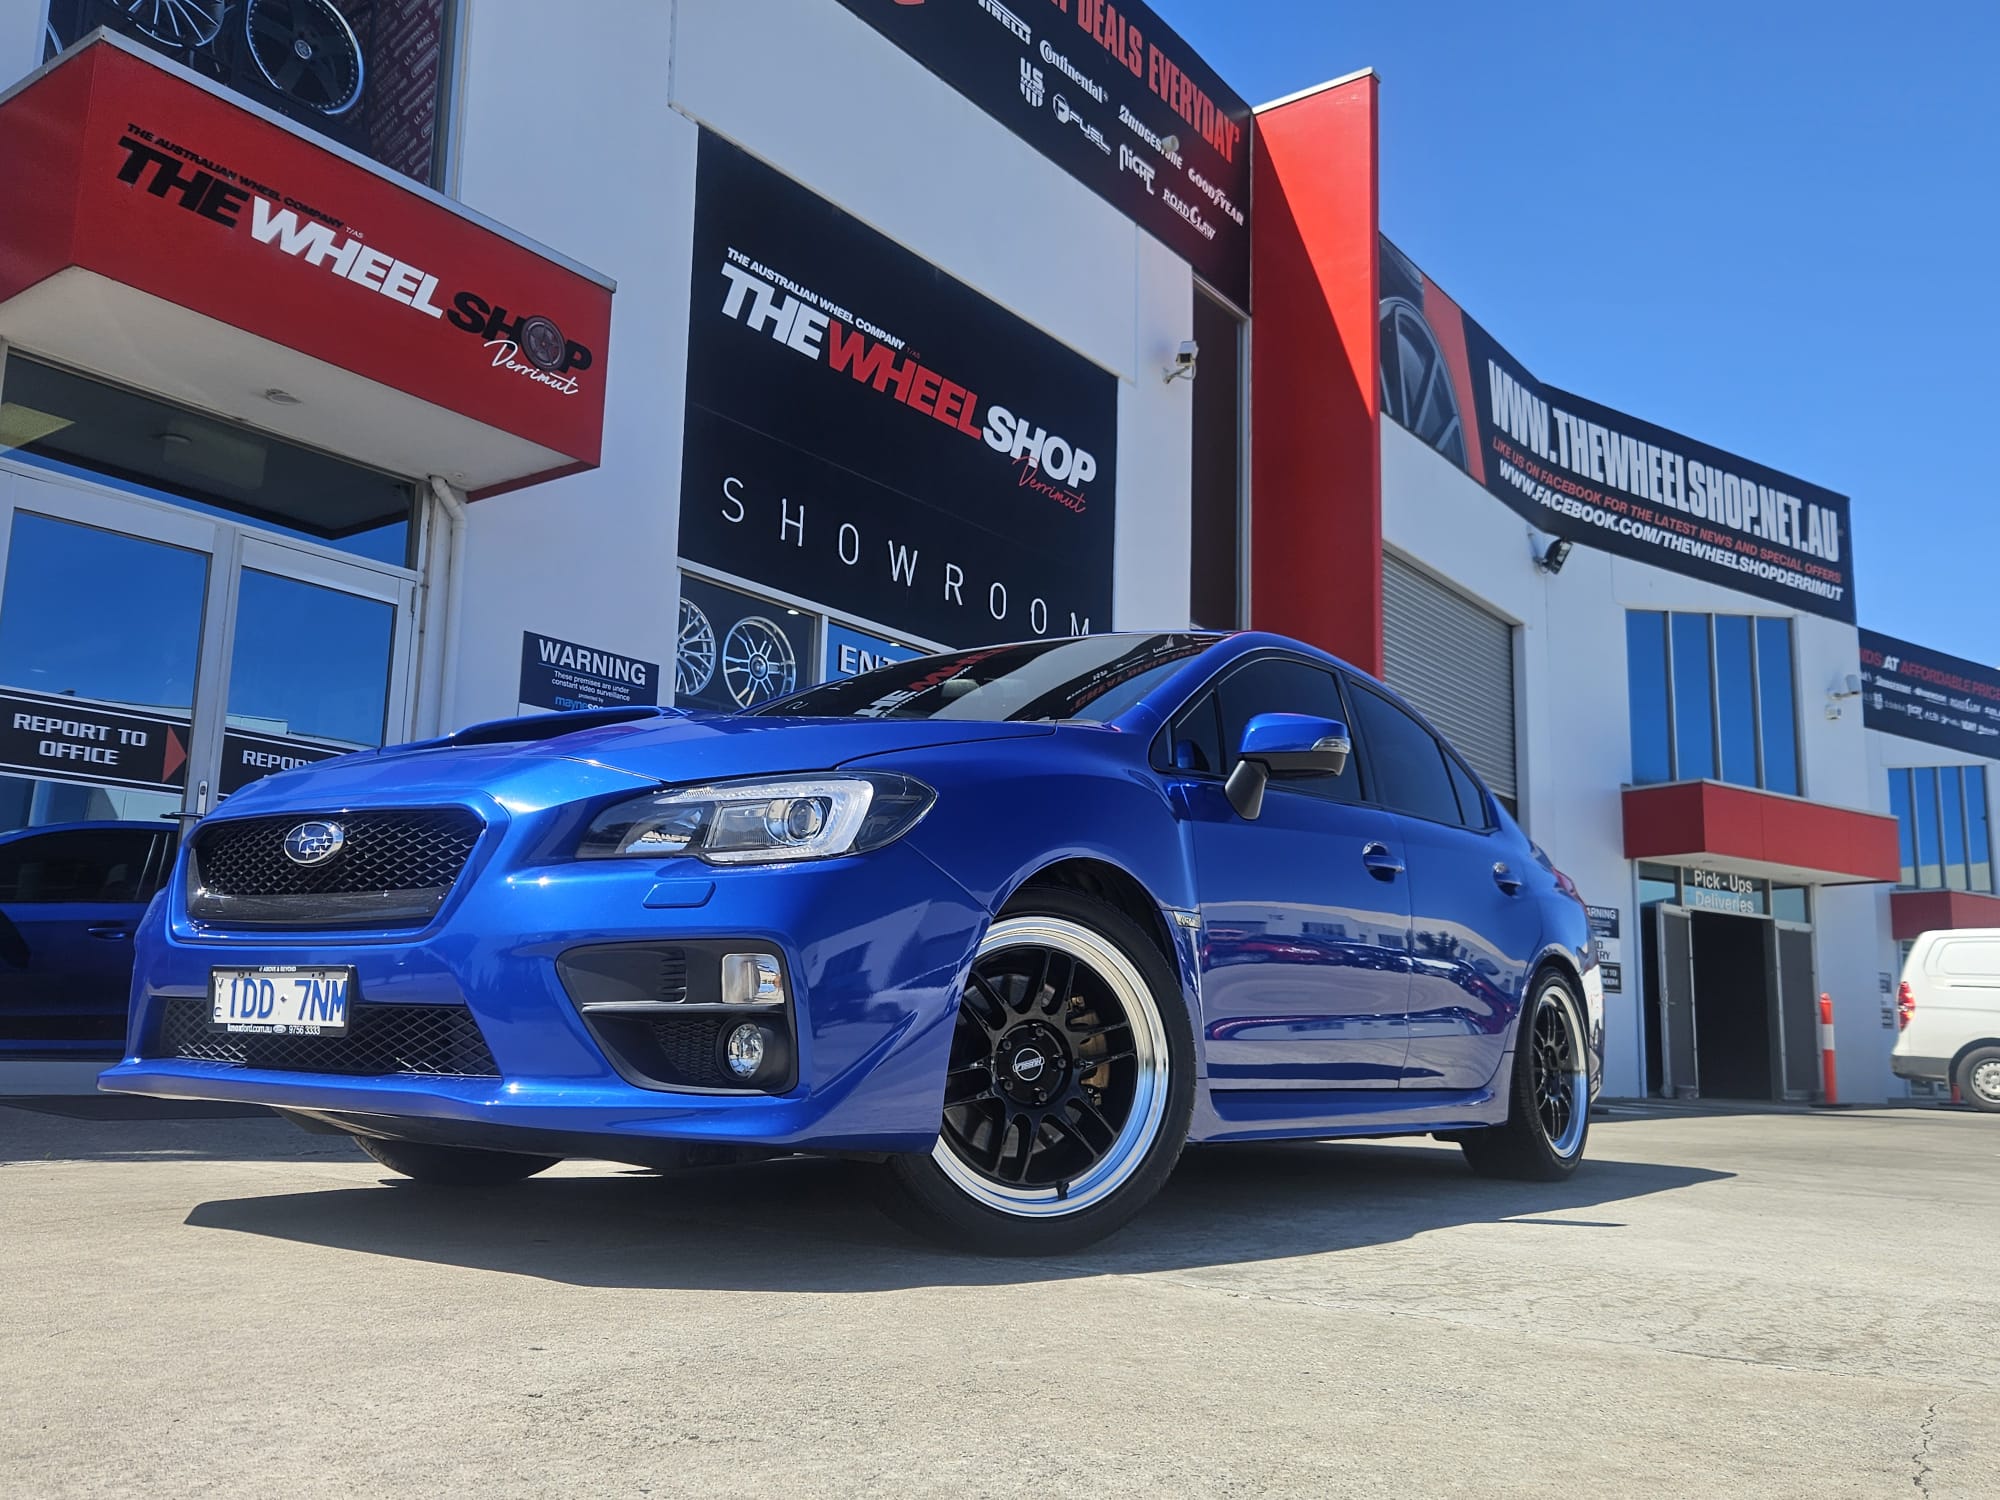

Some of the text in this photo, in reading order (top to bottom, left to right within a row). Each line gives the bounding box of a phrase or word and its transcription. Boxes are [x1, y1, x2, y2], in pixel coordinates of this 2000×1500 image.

[1078, 0, 1143, 78] DEALS
[127, 122, 154, 142] THE
[155, 137, 238, 180] AUSTRALIAN
[239, 175, 281, 202] WHEEL
[283, 196, 344, 229] COMPANY
[117, 135, 250, 230] THE
[251, 195, 444, 319] WHEEL
[727, 246, 750, 267] THE
[750, 260, 818, 305] AUSTRALIAN
[819, 297, 854, 324] WHEEL
[855, 318, 906, 351] COMPANY
[483, 339, 579, 395] Derrimut
[720, 262, 1097, 488] THE WHEEL SHOP
[1011, 455, 1087, 513] Derrimut
[1488, 358, 1840, 563] WWW.THEWHEELSHOP.NET.AU
[1492, 435, 1842, 583] LIKE US ON FACEBOOK FOR THE LATEST NEWS AND SPECIAL OFFERS
[1499, 458, 1844, 602] WWW.FACEBOOK.COM/THEWHEELSHOPDERRIMUT
[538, 638, 646, 686] WARNING
[554, 670, 630, 694] These premises are under
[1882, 655, 1900, 672] AT
[1901, 660, 1972, 692] AFFORDABLE
[551, 679, 631, 702] constant video surveillance
[13, 712, 148, 747] REPORT TO
[38, 740, 121, 766] OFFICE
[1694, 870, 1721, 890] Pick
[1729, 875, 1753, 896] Ups
[1695, 891, 1754, 913] Deliveries
[230, 978, 349, 1022] 1DD 7NM
